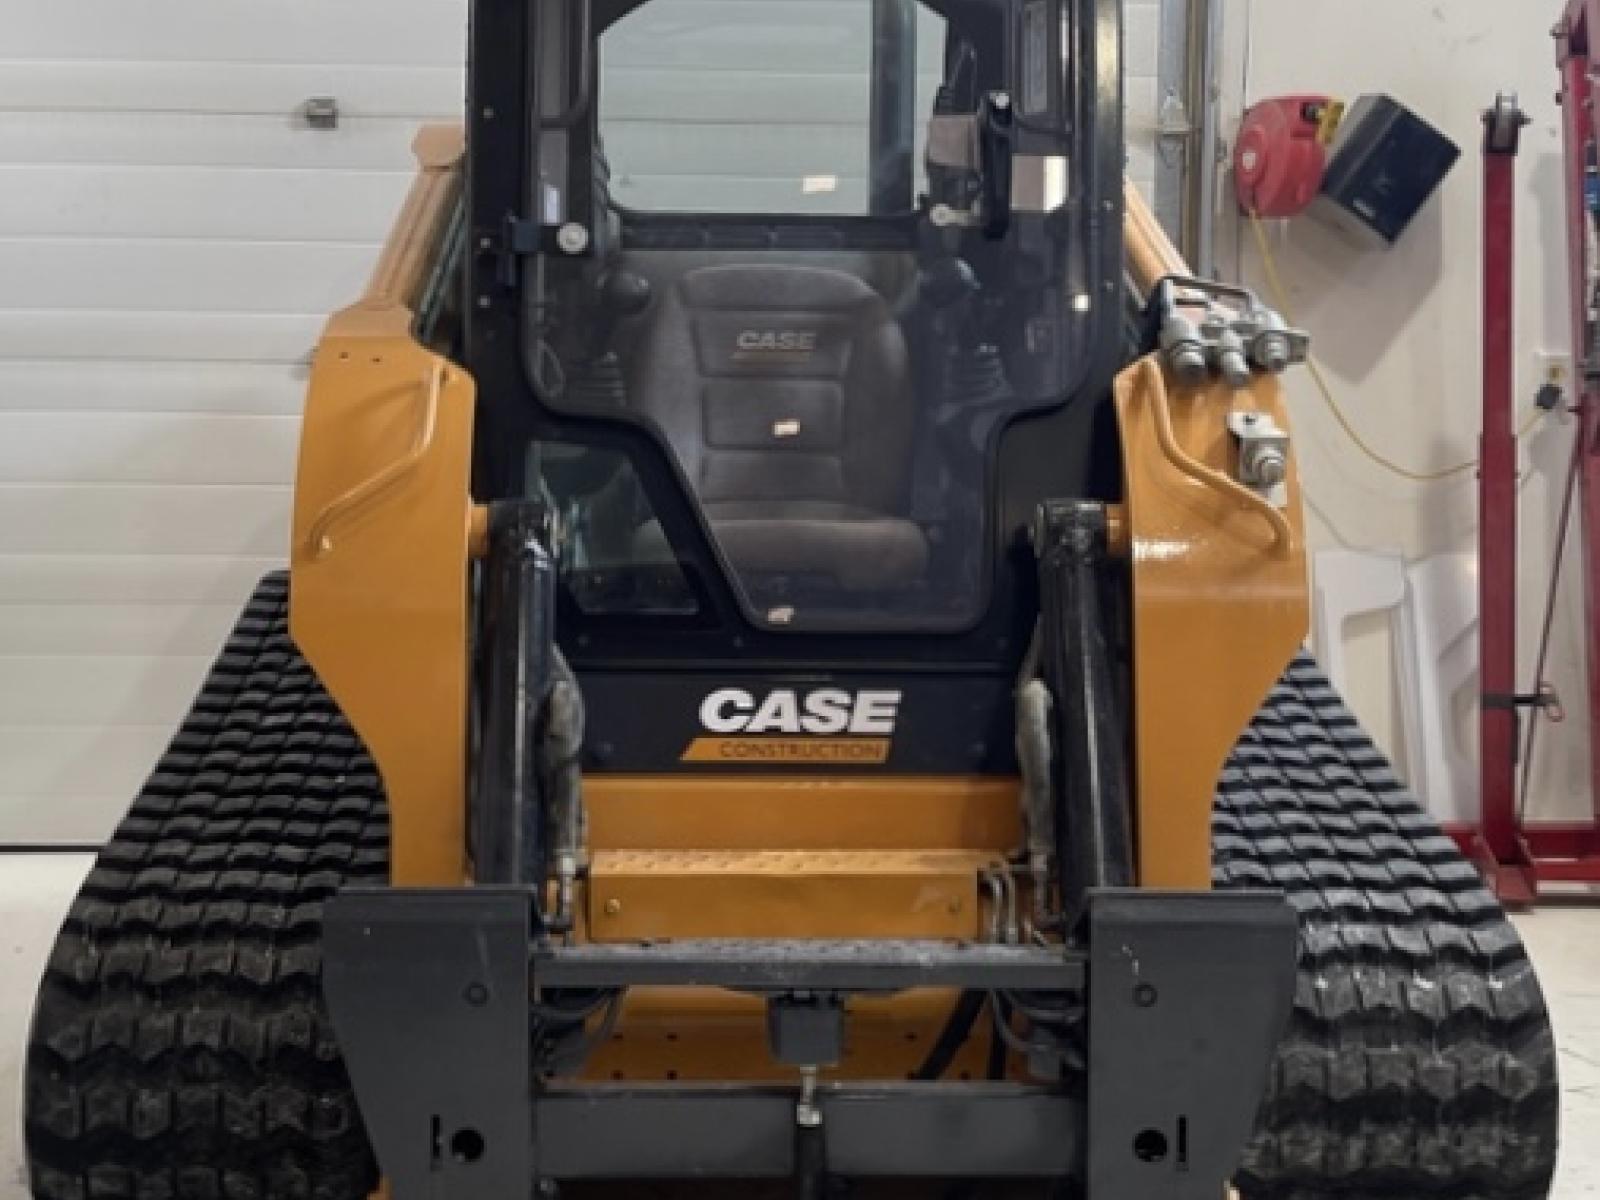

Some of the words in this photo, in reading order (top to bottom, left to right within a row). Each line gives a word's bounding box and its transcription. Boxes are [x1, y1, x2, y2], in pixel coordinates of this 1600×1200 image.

[736, 330, 817, 350] CASE
[699, 688, 902, 734] CASE
[719, 741, 881, 759] CONSTRUCTION
